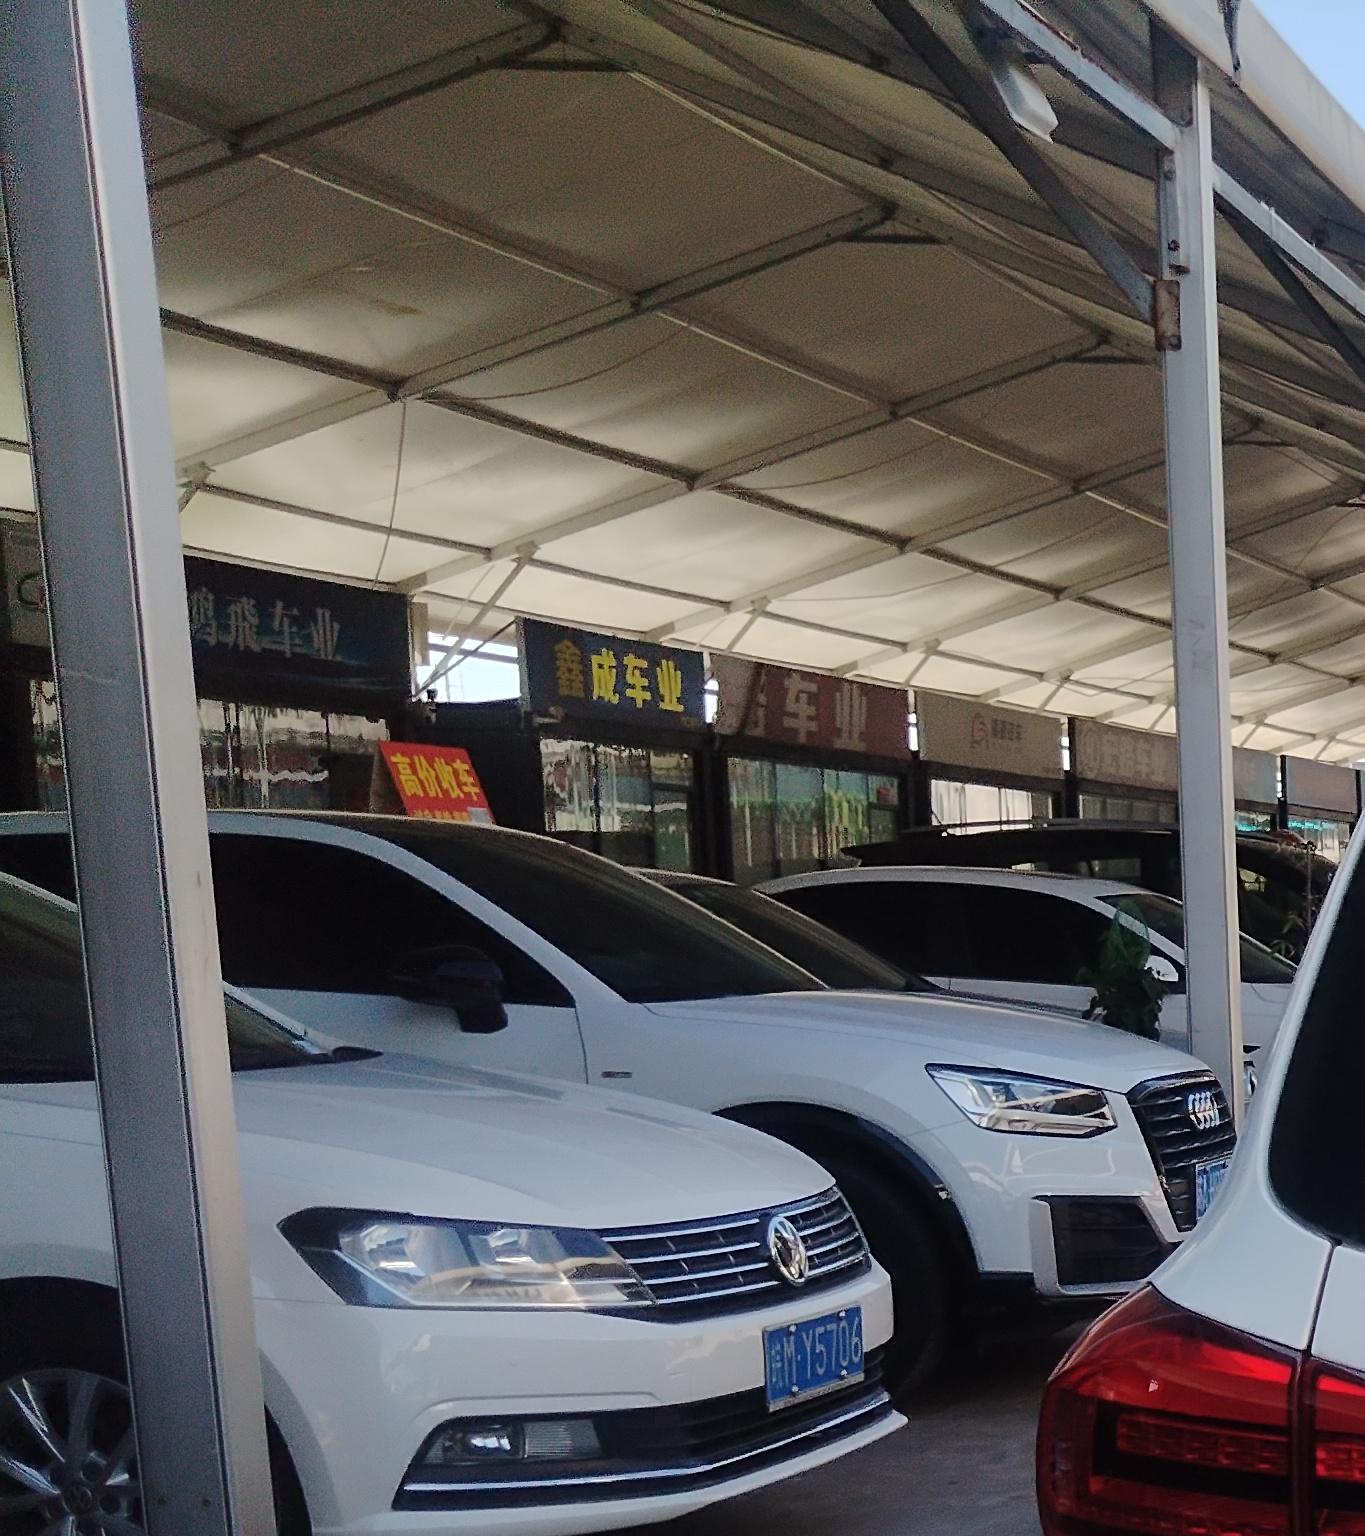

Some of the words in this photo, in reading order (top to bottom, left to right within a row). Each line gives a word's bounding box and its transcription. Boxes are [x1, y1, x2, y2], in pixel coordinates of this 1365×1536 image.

[554, 639, 684, 713] 鑫成车业
[390, 753, 480, 801] 高价收车
